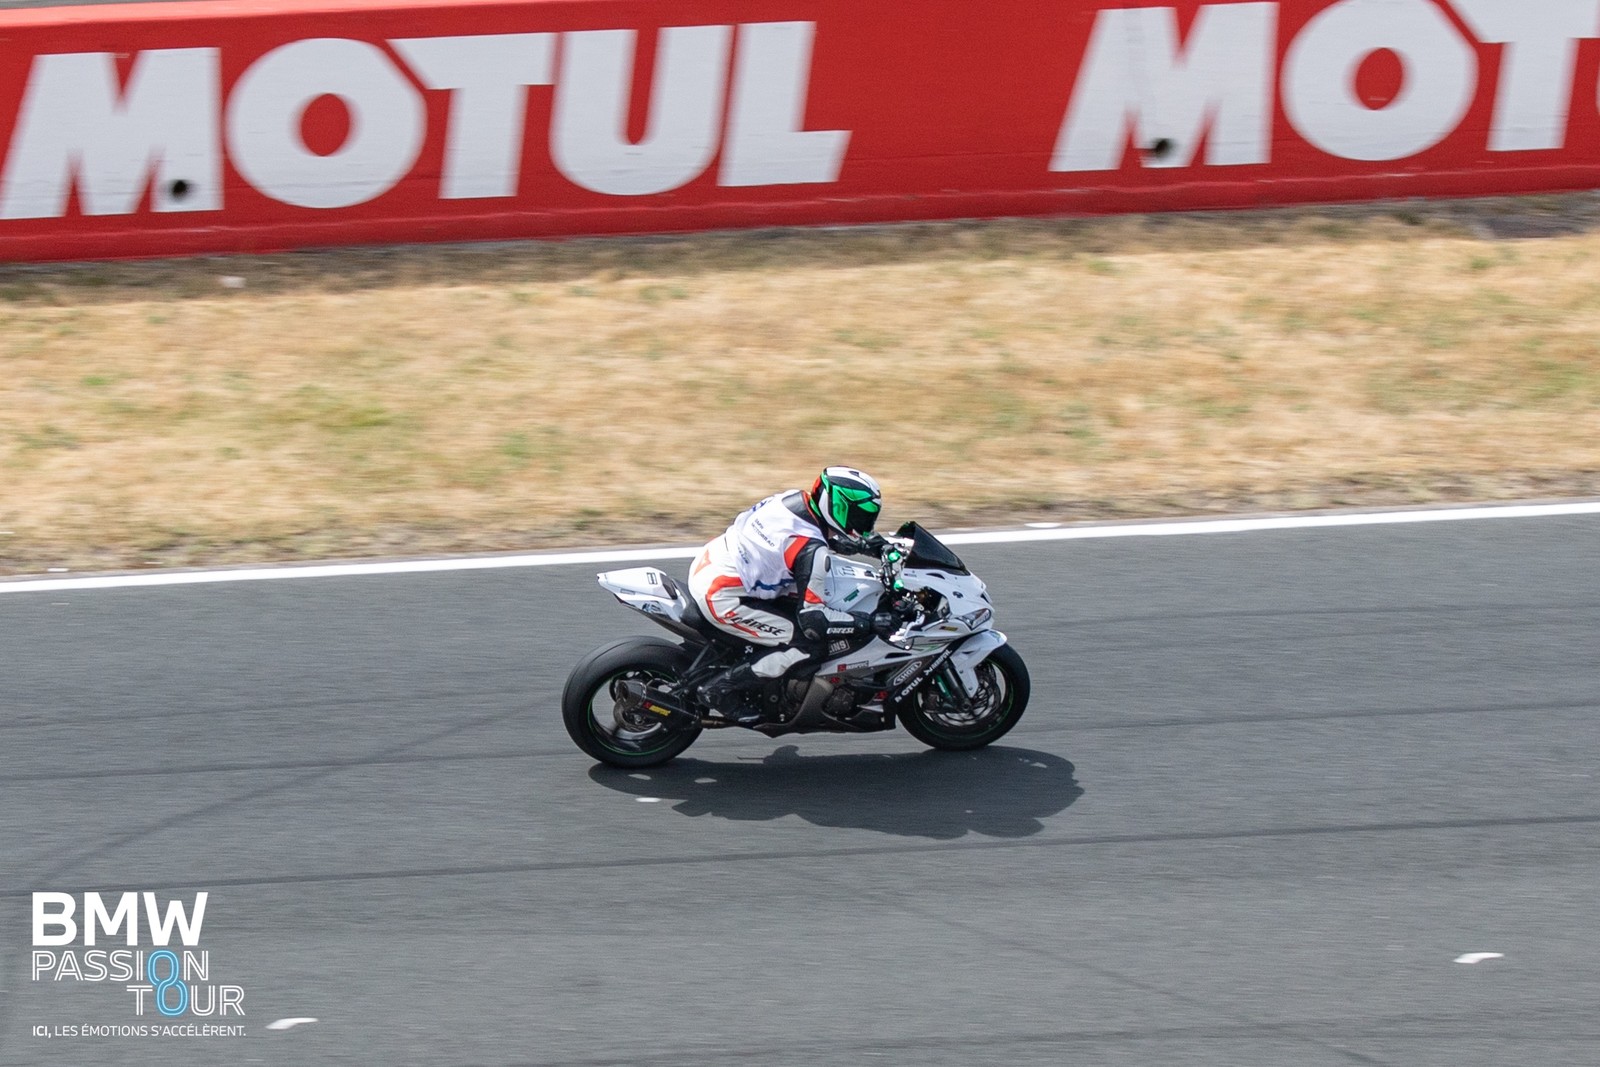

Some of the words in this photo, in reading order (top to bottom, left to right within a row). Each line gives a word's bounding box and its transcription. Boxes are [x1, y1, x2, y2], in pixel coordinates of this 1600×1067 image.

[0, 21, 852, 220] MOTUL
[1048, 0, 1600, 172] MOT
[731, 615, 786, 636] DAINESE
